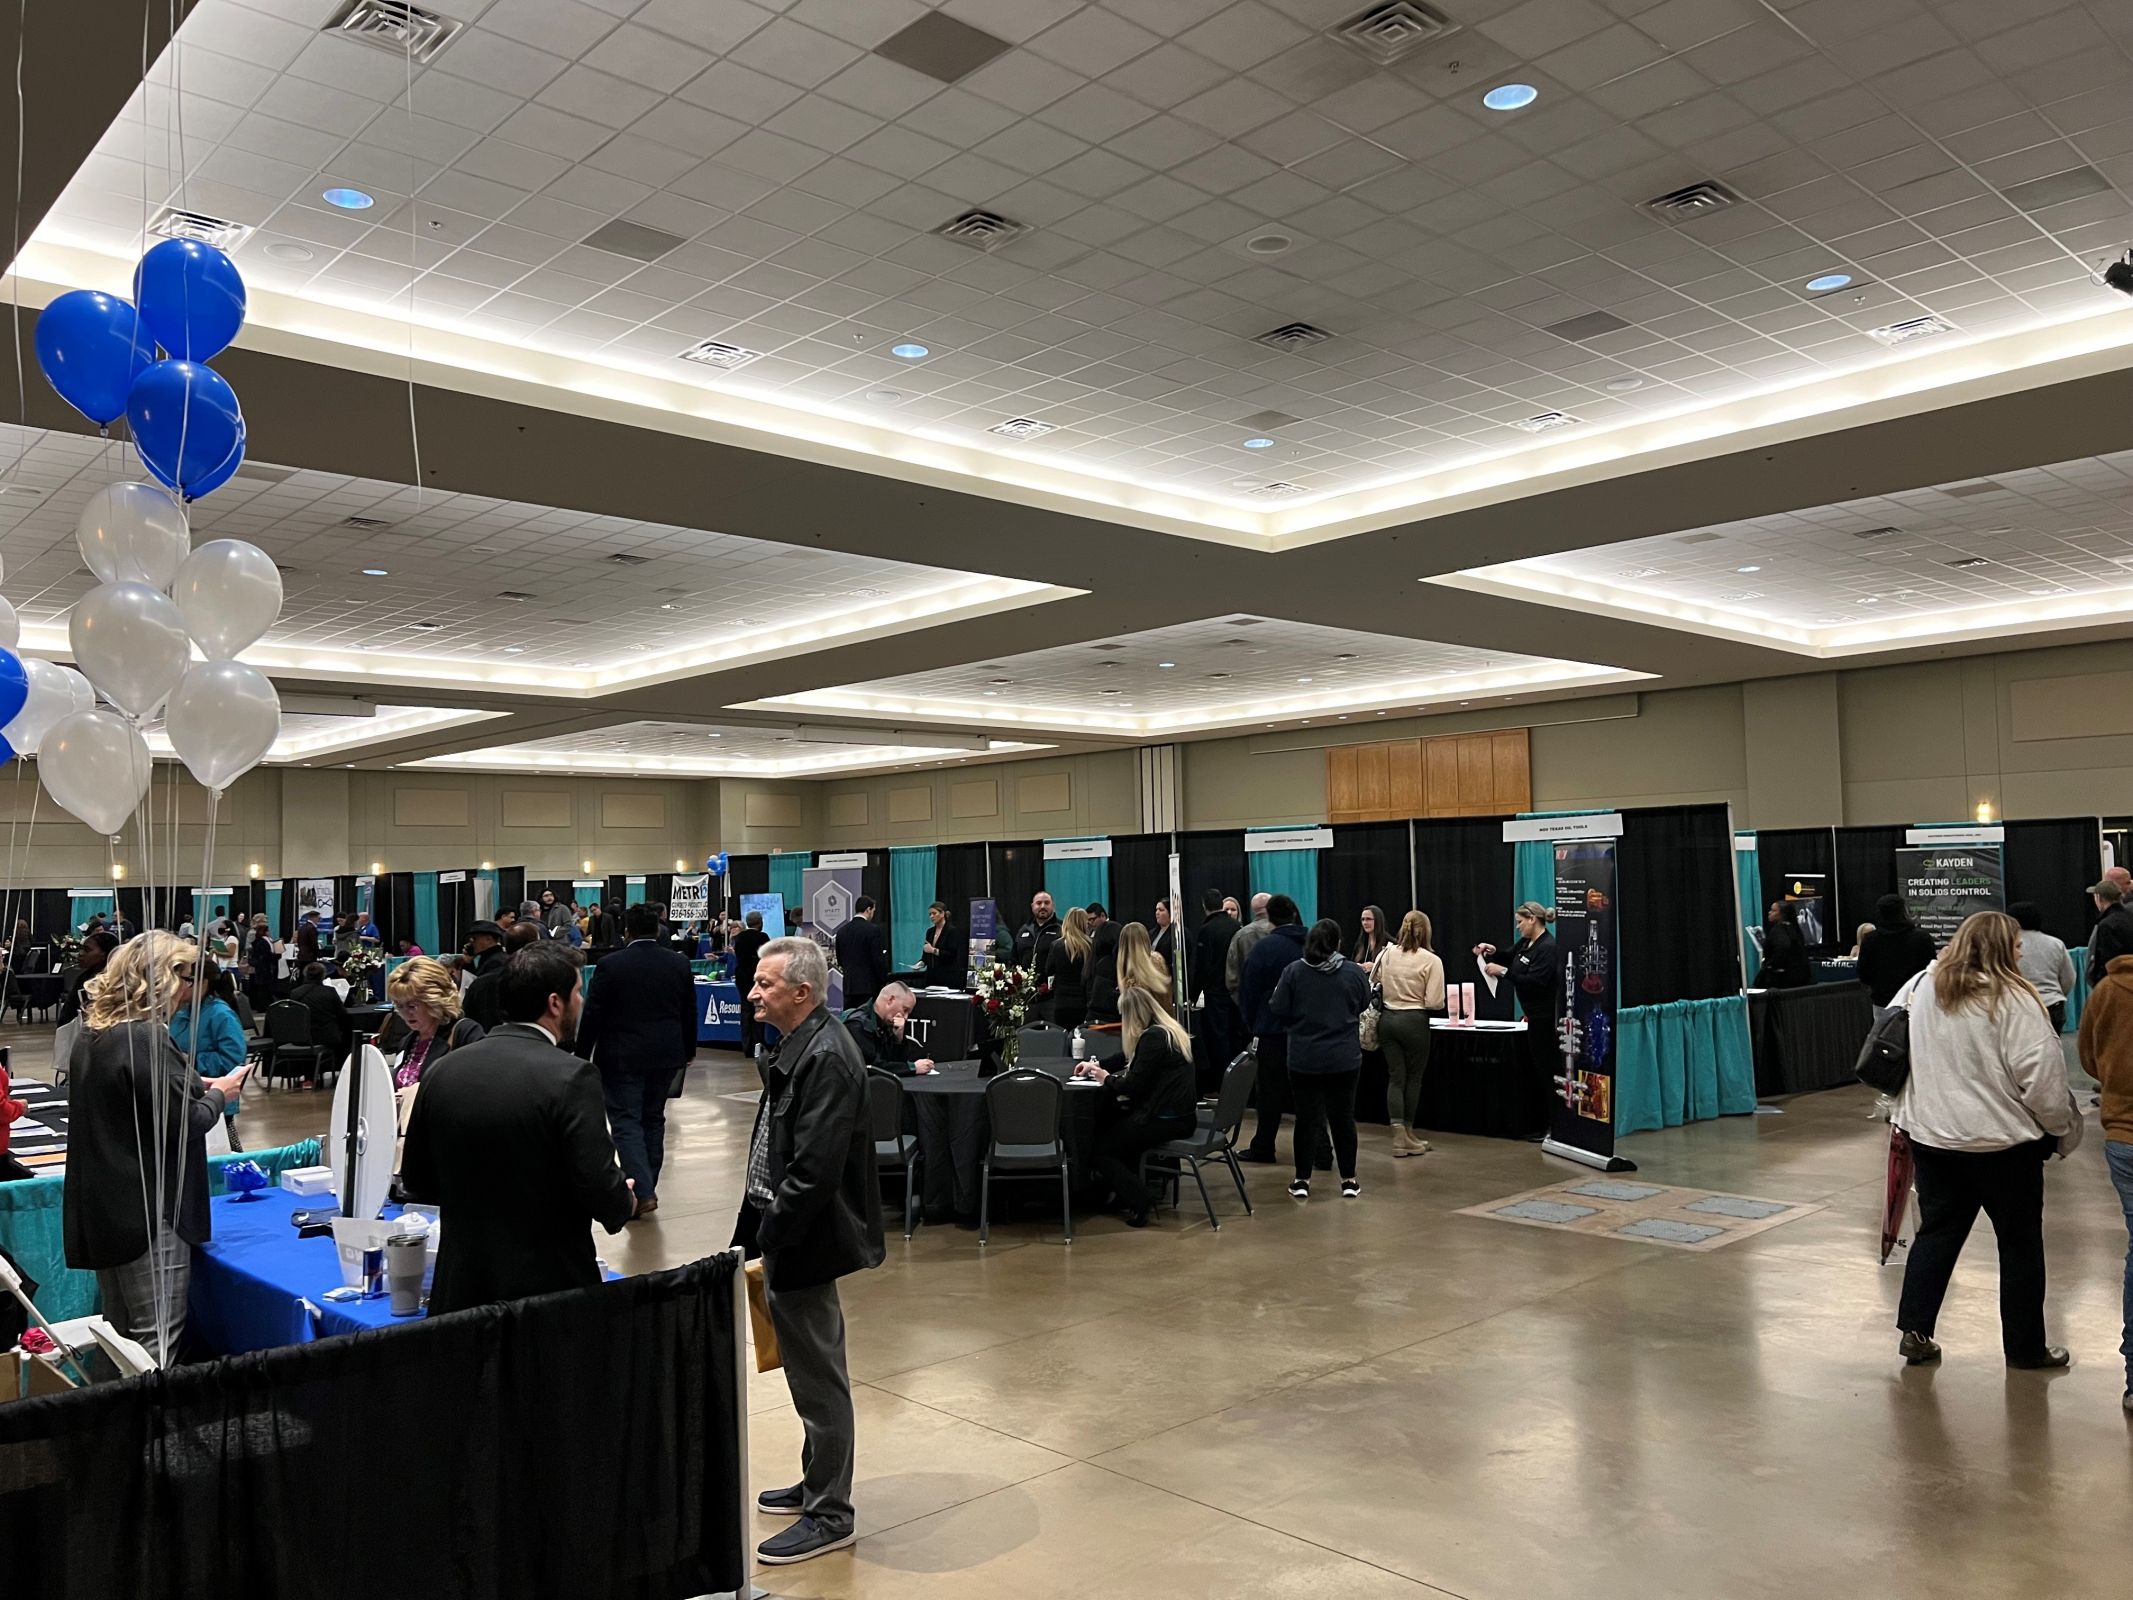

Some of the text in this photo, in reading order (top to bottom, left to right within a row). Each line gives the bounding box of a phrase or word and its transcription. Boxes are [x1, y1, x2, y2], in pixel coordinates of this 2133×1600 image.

[1936, 857, 1974, 868] KAYDEN
[1908, 878, 1992, 886] CREATING LEADERS
[1908, 888, 1992, 896] IN SOLIDS CONTROL
